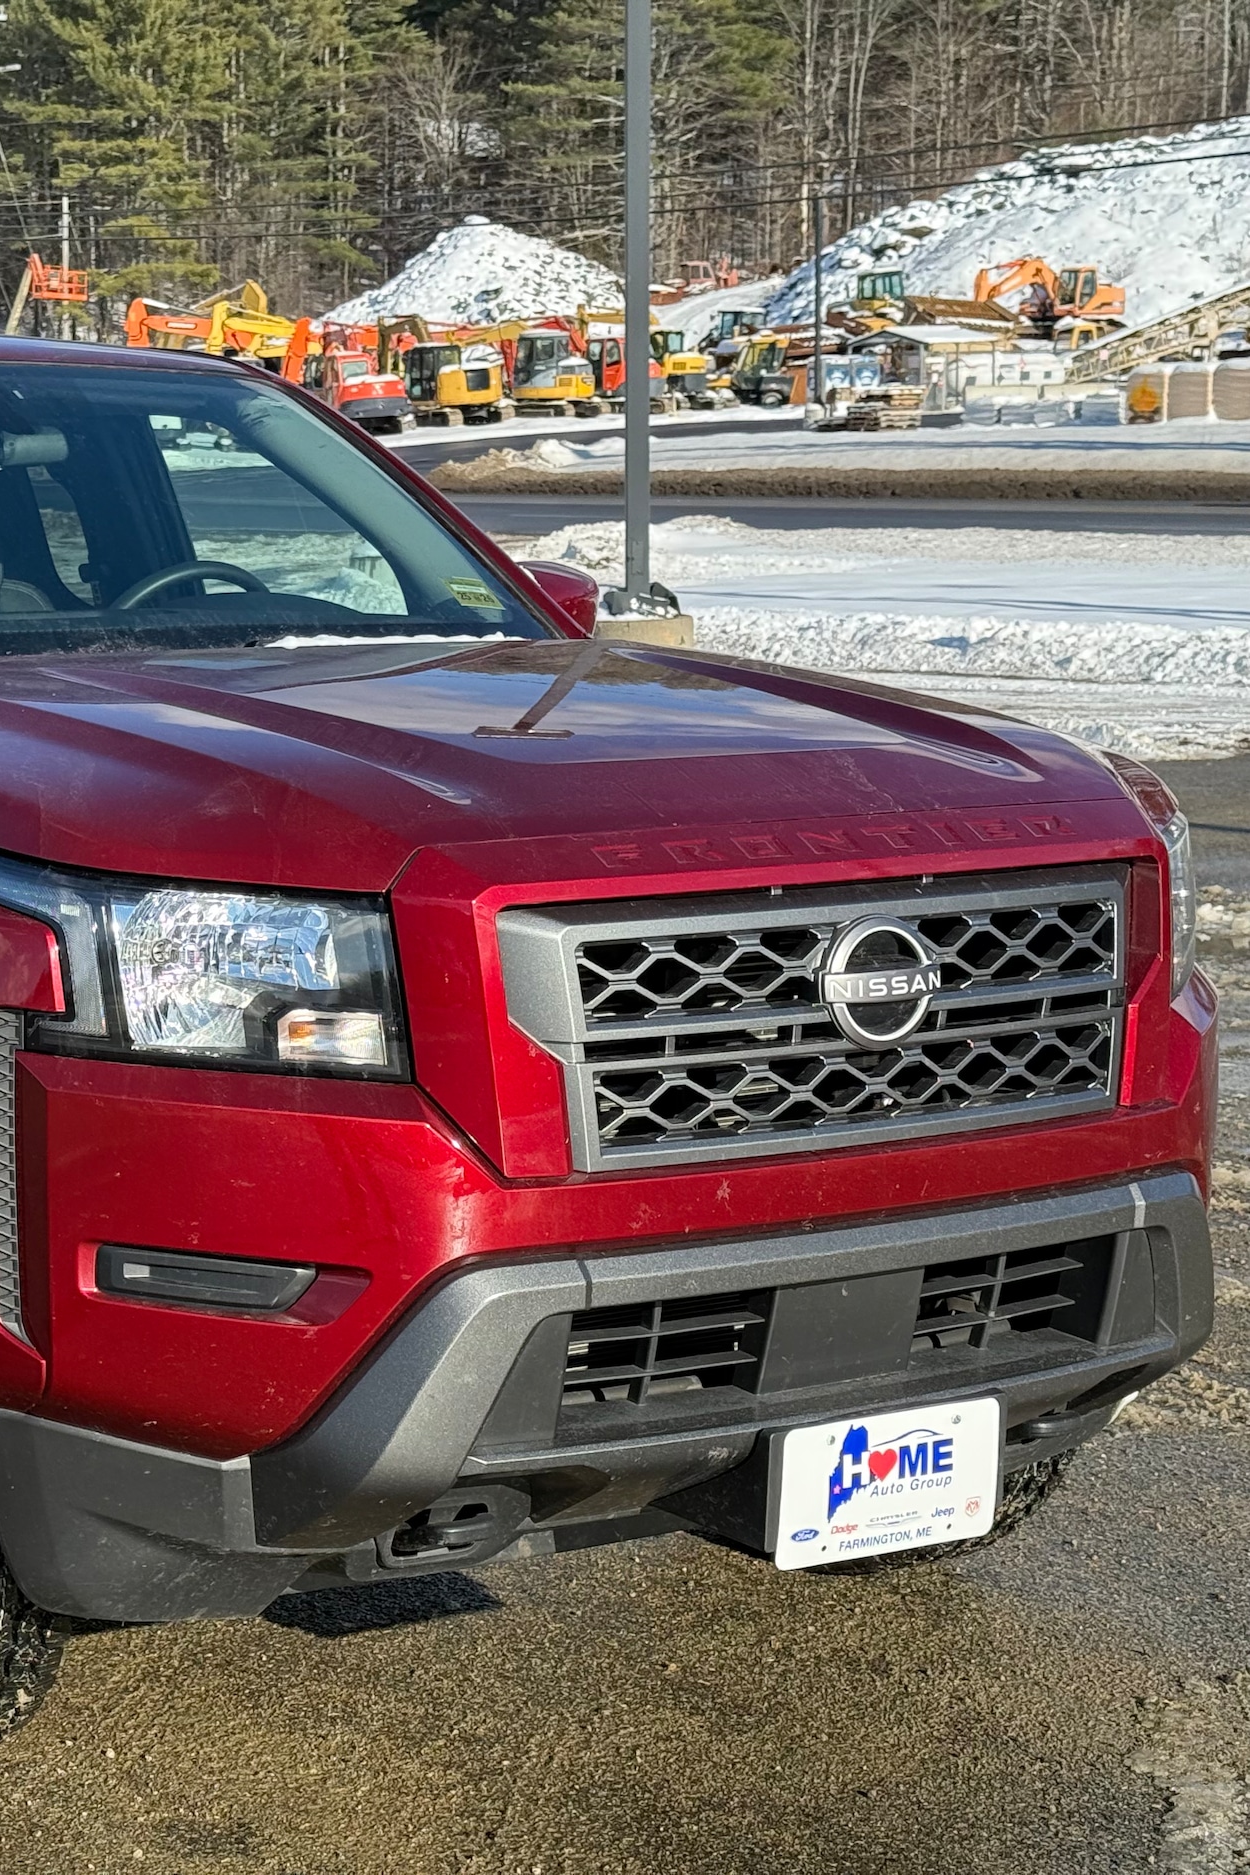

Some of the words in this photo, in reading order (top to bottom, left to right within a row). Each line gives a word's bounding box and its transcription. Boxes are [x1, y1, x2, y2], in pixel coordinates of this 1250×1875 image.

[590, 813, 1076, 868] FRONTIER
[830, 969, 942, 1000] NISSAN
[869, 1481, 904, 1499] Auto
[910, 1475, 953, 1492] Group
[830, 1523, 859, 1536] Dodge
[930, 1505, 955, 1519] Jeep
[838, 1529, 913, 1552] FARMINGTON,
[916, 1526, 933, 1539] ME
